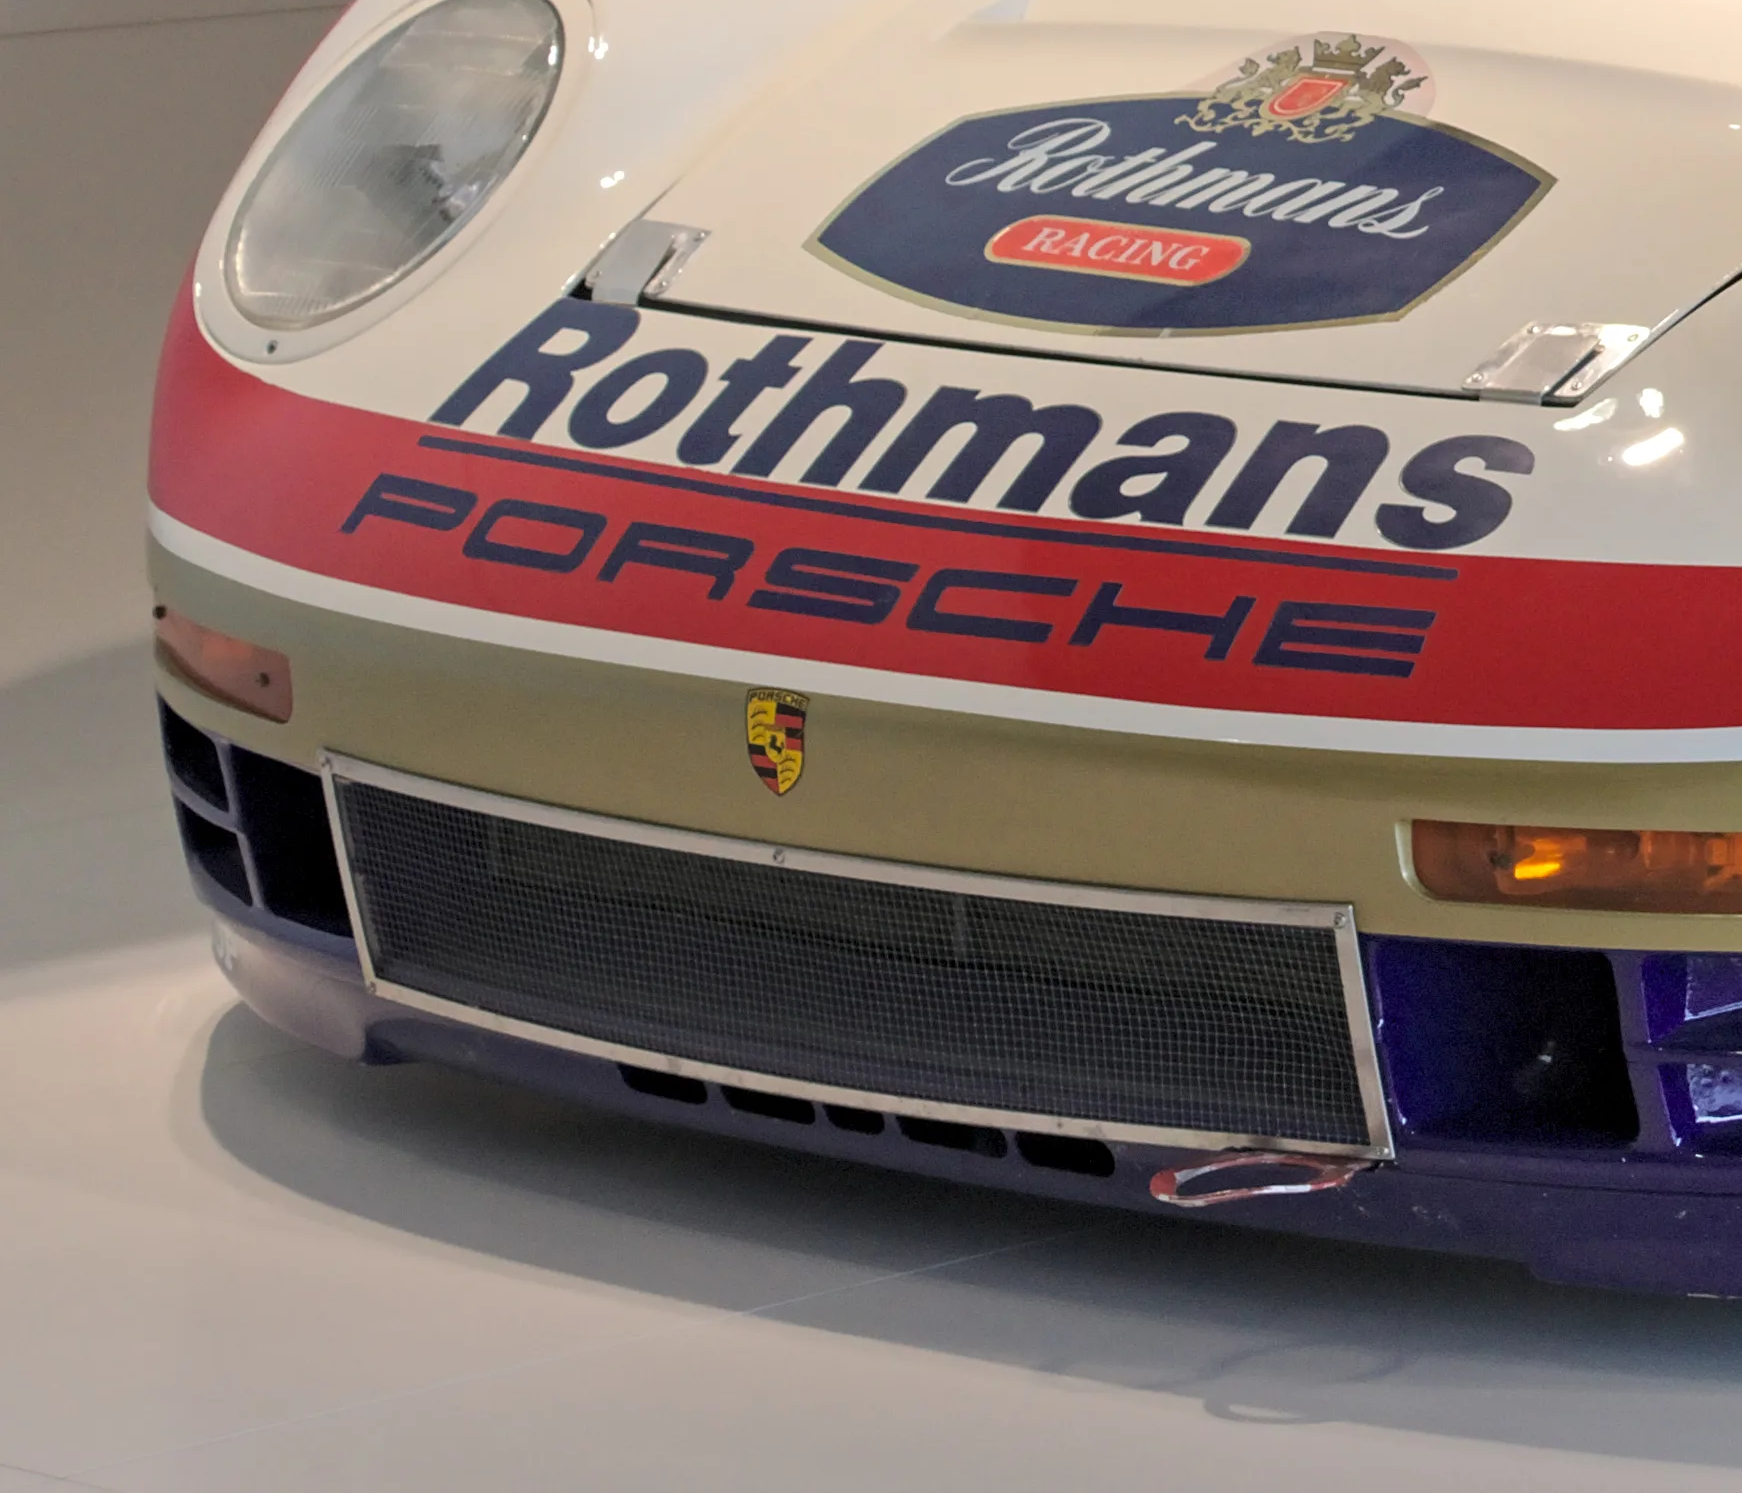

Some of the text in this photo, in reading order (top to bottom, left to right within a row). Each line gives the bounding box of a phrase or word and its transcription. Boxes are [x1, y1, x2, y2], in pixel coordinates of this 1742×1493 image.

[945, 117, 1445, 240] Rothmans
[1020, 225, 1211, 273] RACING
[428, 297, 1537, 549] Rothmans
[338, 472, 1437, 679] PORSCHE
